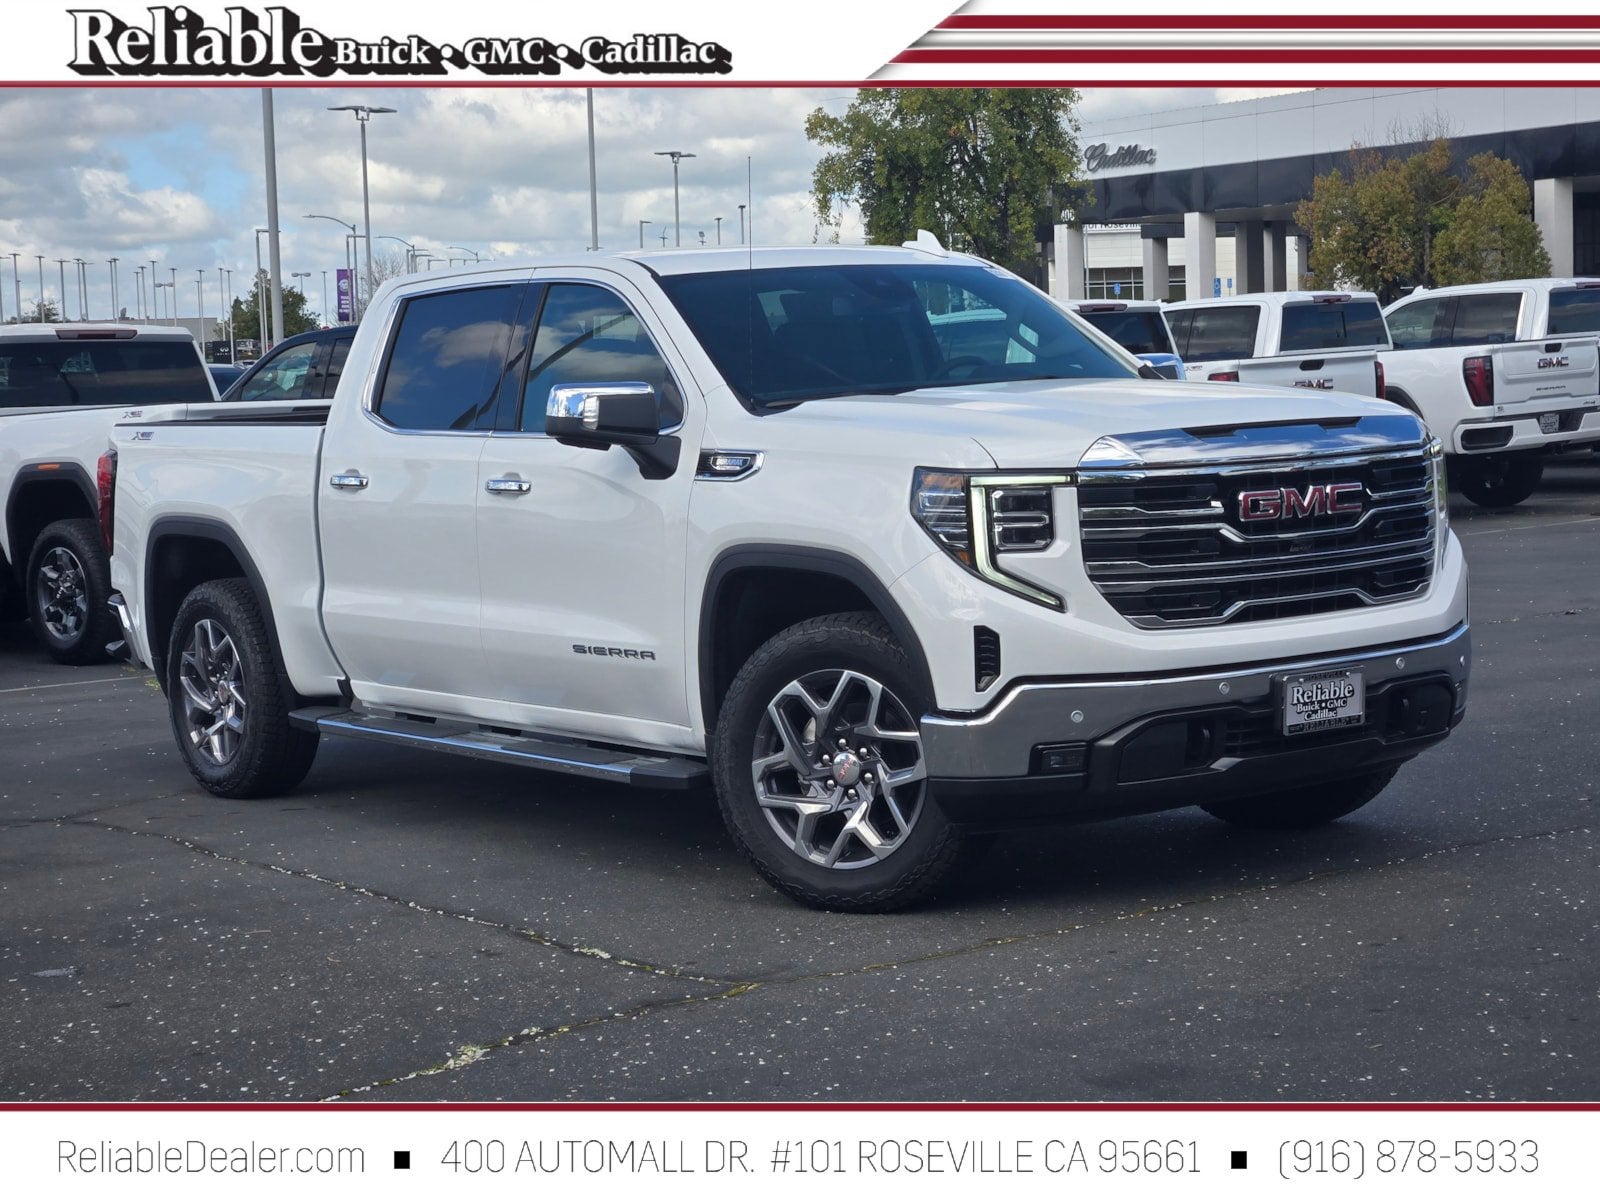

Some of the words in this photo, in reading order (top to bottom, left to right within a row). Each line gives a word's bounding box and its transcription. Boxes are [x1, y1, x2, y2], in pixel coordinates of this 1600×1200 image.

[1084, 142, 1156, 172] Cadillac
[1537, 356, 1569, 369] GMC
[1238, 482, 1363, 521] GMC
[572, 644, 656, 661] SIERRA
[1291, 680, 1354, 705] Reliable
[1296, 702, 1320, 713] Buick
[1326, 698, 1348, 708] GMC
[1303, 709, 1338, 721] Cadillac
